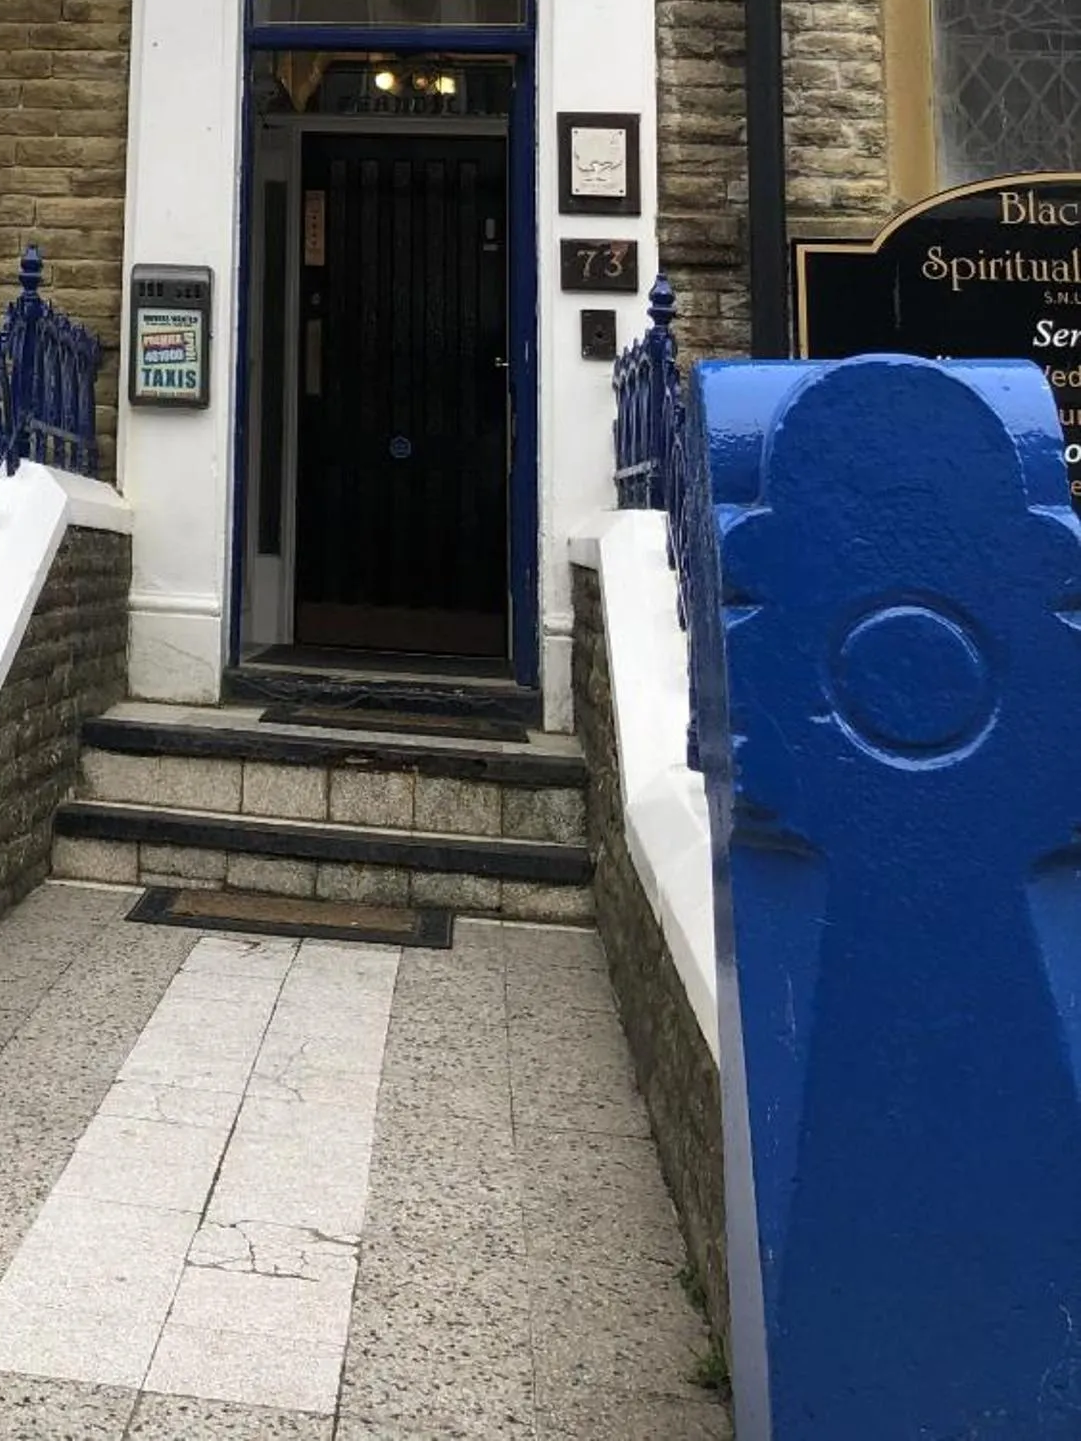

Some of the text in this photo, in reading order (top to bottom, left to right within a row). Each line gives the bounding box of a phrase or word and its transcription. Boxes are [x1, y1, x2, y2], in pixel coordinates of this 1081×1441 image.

[577, 250, 623, 279] 73
[923, 247, 1081, 291] Spiritual
[142, 368, 197, 388] TAXIS
